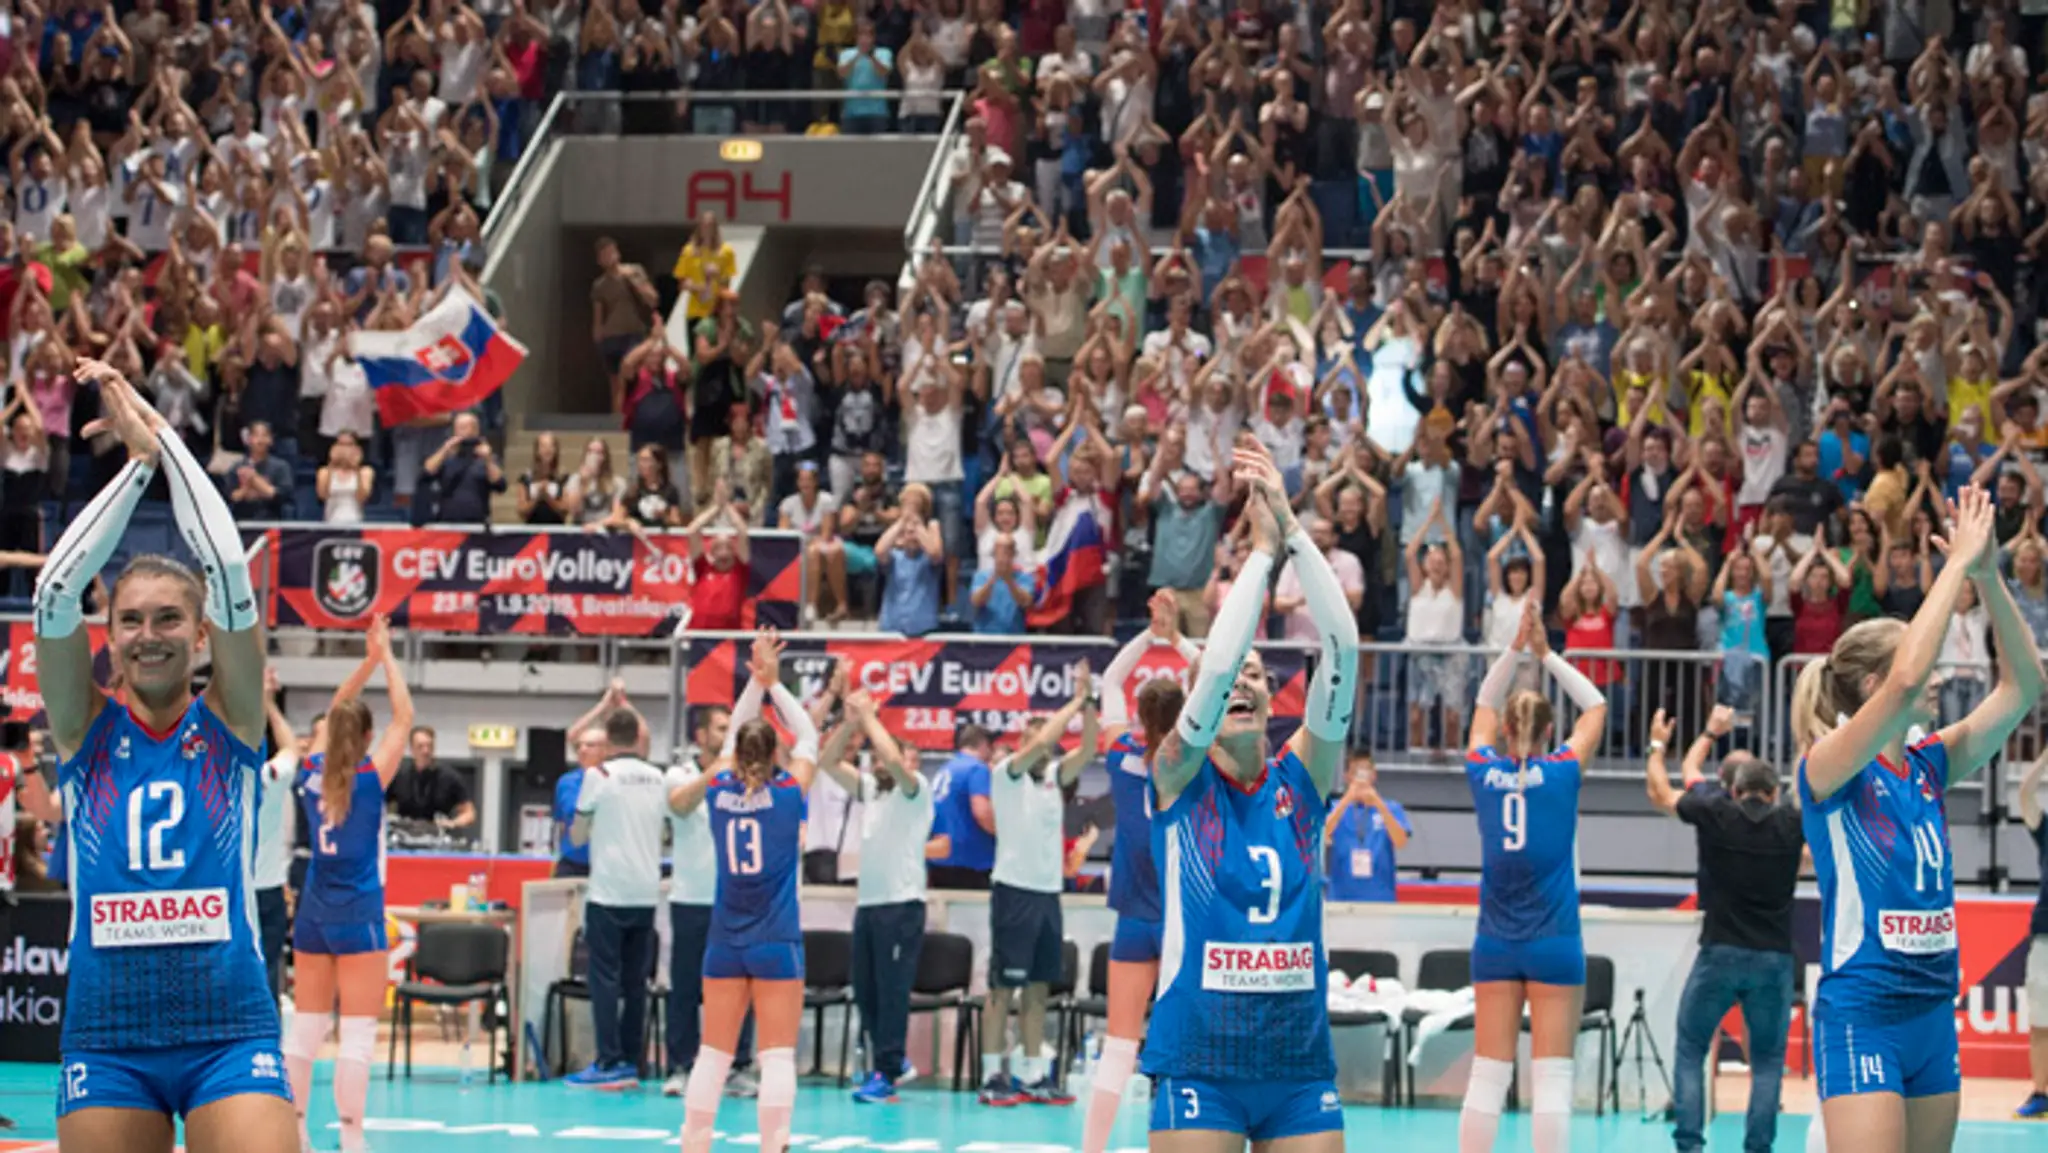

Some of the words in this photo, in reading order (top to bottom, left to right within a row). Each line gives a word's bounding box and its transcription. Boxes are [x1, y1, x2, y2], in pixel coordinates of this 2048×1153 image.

[687, 169, 793, 222] A4
[392, 548, 461, 580] CEV
[466, 549, 634, 589] EuroVolley
[642, 553, 696, 585] 201
[860, 661, 934, 694] CEV
[128, 781, 185, 870] 12
[1503, 792, 1526, 851] 9
[726, 818, 763, 874] 13
[1912, 820, 1944, 892] 14
[1247, 846, 1282, 923] 3
[93, 894, 224, 924] STRABAG
[105, 926, 156, 940] TEAMS
[2, 935, 70, 976] slav
[1208, 947, 1313, 971] STRABAG
[1222, 974, 1269, 987] TEAMS
[0, 987, 60, 1025] kia
[66, 1063, 88, 1100] 12
[1860, 1053, 1885, 1084] 14
[1181, 1088, 1199, 1119] 3
